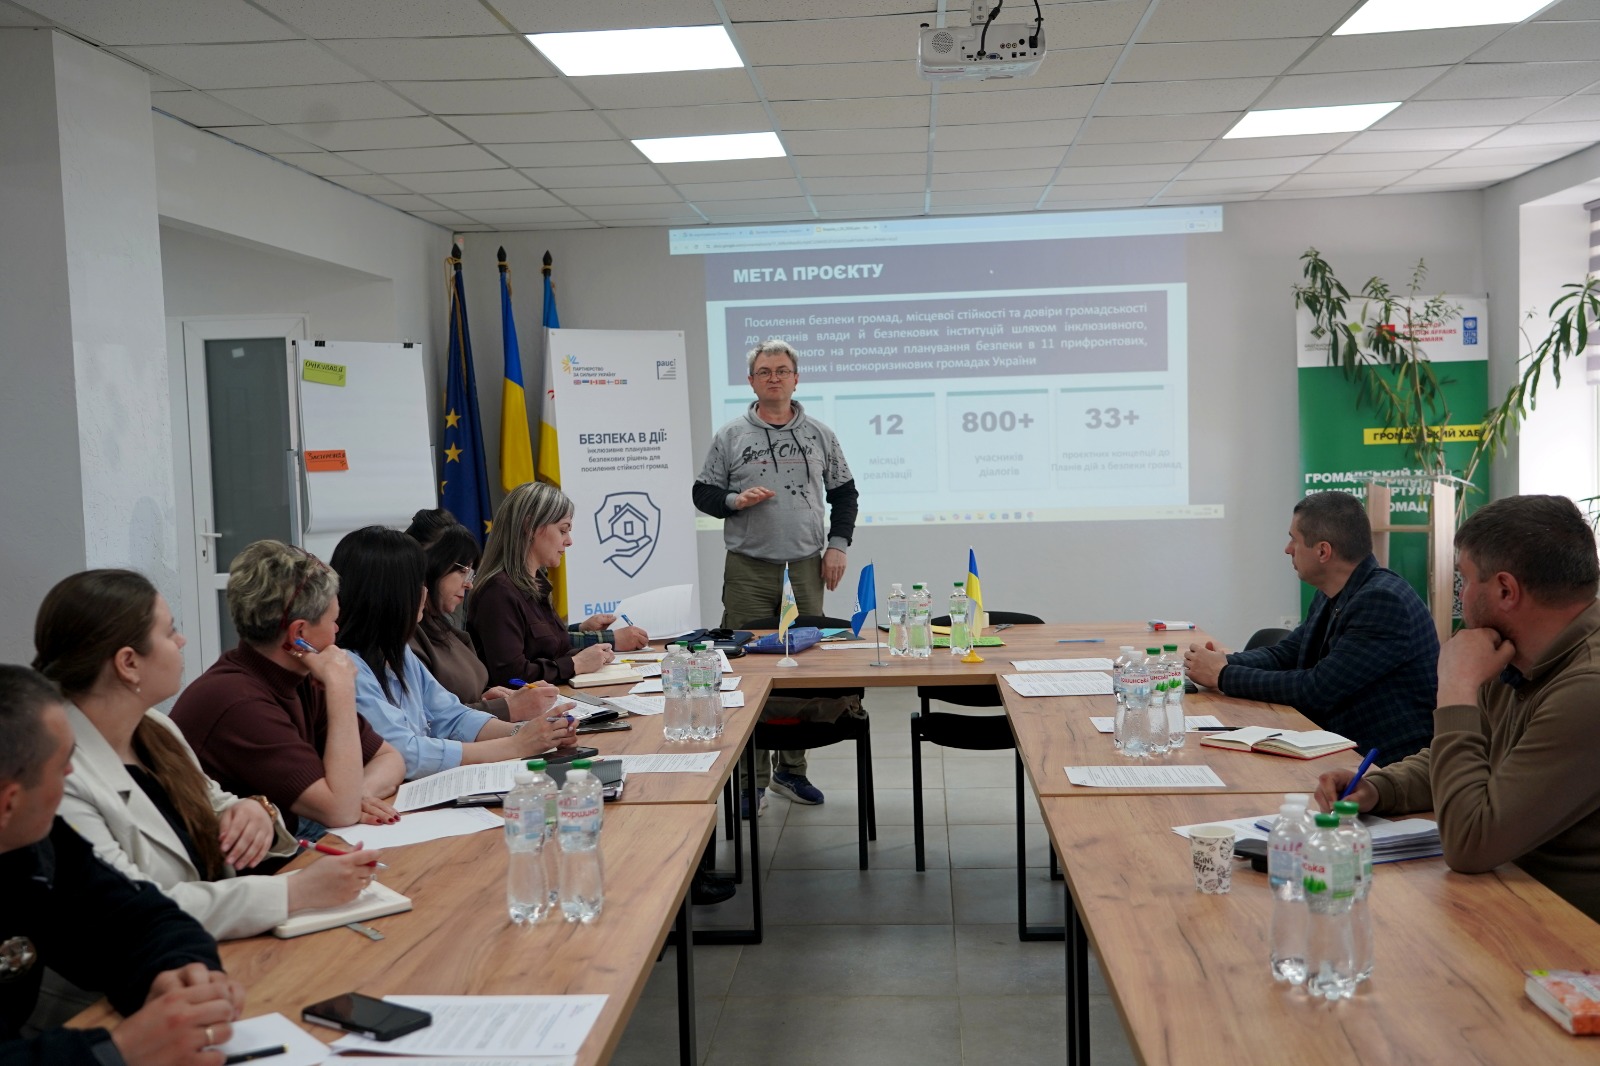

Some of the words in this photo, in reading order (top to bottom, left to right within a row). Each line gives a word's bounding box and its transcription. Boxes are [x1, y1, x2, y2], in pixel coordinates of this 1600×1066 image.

[733, 268, 787, 283] МЕТА
[793, 263, 883, 281] ПРОЄКТУ
[744, 317, 805, 328] Посилення
[809, 314, 854, 325] безпеки
[858, 313, 903, 328] громад,
[906, 309, 954, 323] місцевої
[957, 308, 1005, 320] стійкості
[1009, 309, 1021, 318] та
[1023, 306, 1062, 319] довіри
[1065, 303, 1147, 317] громадськості
[745, 334, 759, 345] до
[767, 331, 808, 342] органів
[817, 332, 850, 342] влади
[859, 329, 866, 340] й
[874, 327, 939, 339] безпекових
[946, 324, 1004, 337] інституцій
[1011, 324, 1056, 334] шляхом
[1064, 321, 1148, 333] інклюзивного,
[831, 348, 844, 356] на
[850, 346, 898, 358] громади
[903, 342, 970, 355] планування
[975, 340, 1023, 351] безпеки
[1028, 341, 1035, 349] в
[1041, 339, 1054, 349] 11
[1060, 336, 1148, 350] прифронтових,
[836, 359, 934, 373] високоризикових
[936, 357, 990, 370] громадах
[992, 354, 1037, 367] України
[869, 414, 904, 435] 12
[961, 411, 1034, 433] 800+
[1084, 407, 1140, 429] 33+
[579, 432, 636, 445] БЕЗПЕКА
[638, 432, 646, 443] В
[649, 428, 667, 444] ДІЇ:
[617, 463, 645, 471] стійкості
[646, 463, 669, 471] громад
[626, 455, 648, 463] рішень
[869, 456, 905, 466] місяців
[974, 453, 1024, 464] учасників
[863, 470, 912, 481] реалізації
[979, 467, 1020, 478] діалогів
[1390, 501, 1428, 513] ОМАД
[584, 600, 621, 616] БАШ
